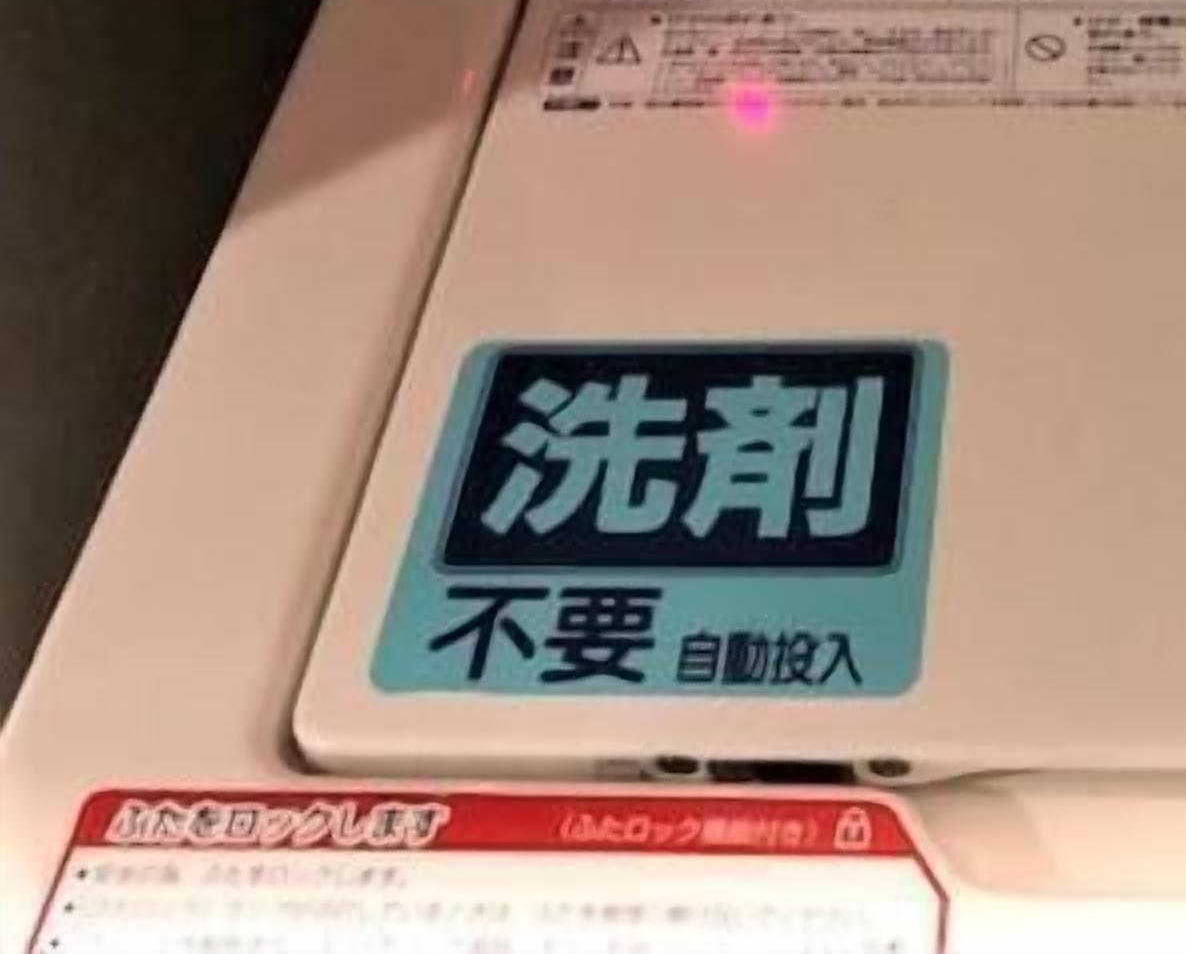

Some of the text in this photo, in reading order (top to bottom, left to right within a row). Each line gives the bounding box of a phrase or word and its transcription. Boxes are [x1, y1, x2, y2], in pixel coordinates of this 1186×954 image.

[481, 375, 885, 540] 洗剤
[428, 587, 863, 686] 不要 自動投入
[105, 799, 451, 846] ふたをロックします
